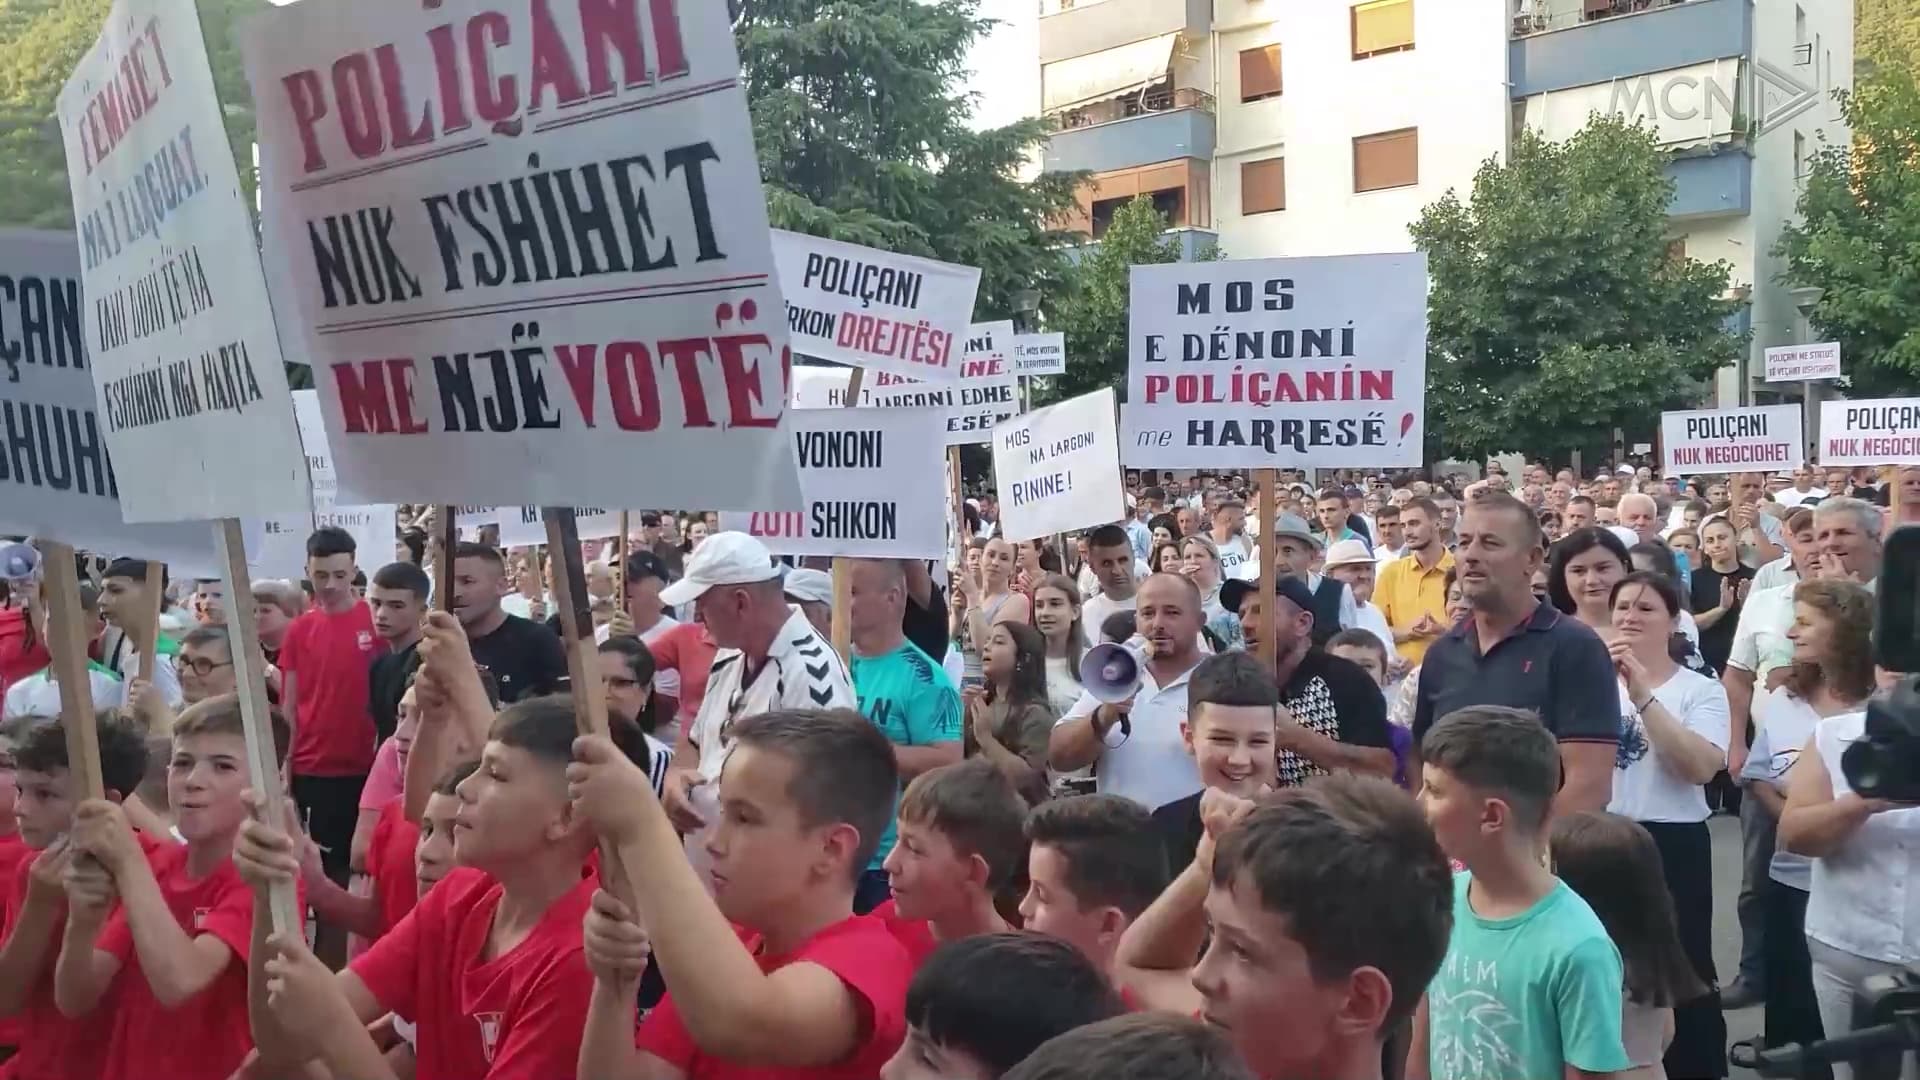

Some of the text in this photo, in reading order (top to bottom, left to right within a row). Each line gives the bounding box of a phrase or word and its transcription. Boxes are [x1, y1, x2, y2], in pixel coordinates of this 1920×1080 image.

[307, 207, 422, 308] NUK
[803, 251, 923, 309] POLIÇANI
[1176, 278, 1295, 315] MOS
[0, 274, 91, 383] ÇAN
[785, 300, 953, 368] RKON DREJTËSI
[1145, 334, 1167, 362] E
[331, 358, 429, 434] ME
[960, 384, 1013, 407] EDHE
[1005, 428, 1030, 450] MOS
[1136, 429, 1173, 447] me
[1686, 413, 1768, 443] POLIÇANI
[796, 430, 882, 468] VONONI
[1030, 431, 1095, 465] NA LARGONI
[1673, 443, 1790, 465] NUK NEGOCIOHET
[1829, 438, 1859, 457] NUK
[811, 501, 897, 540] SHIKON
